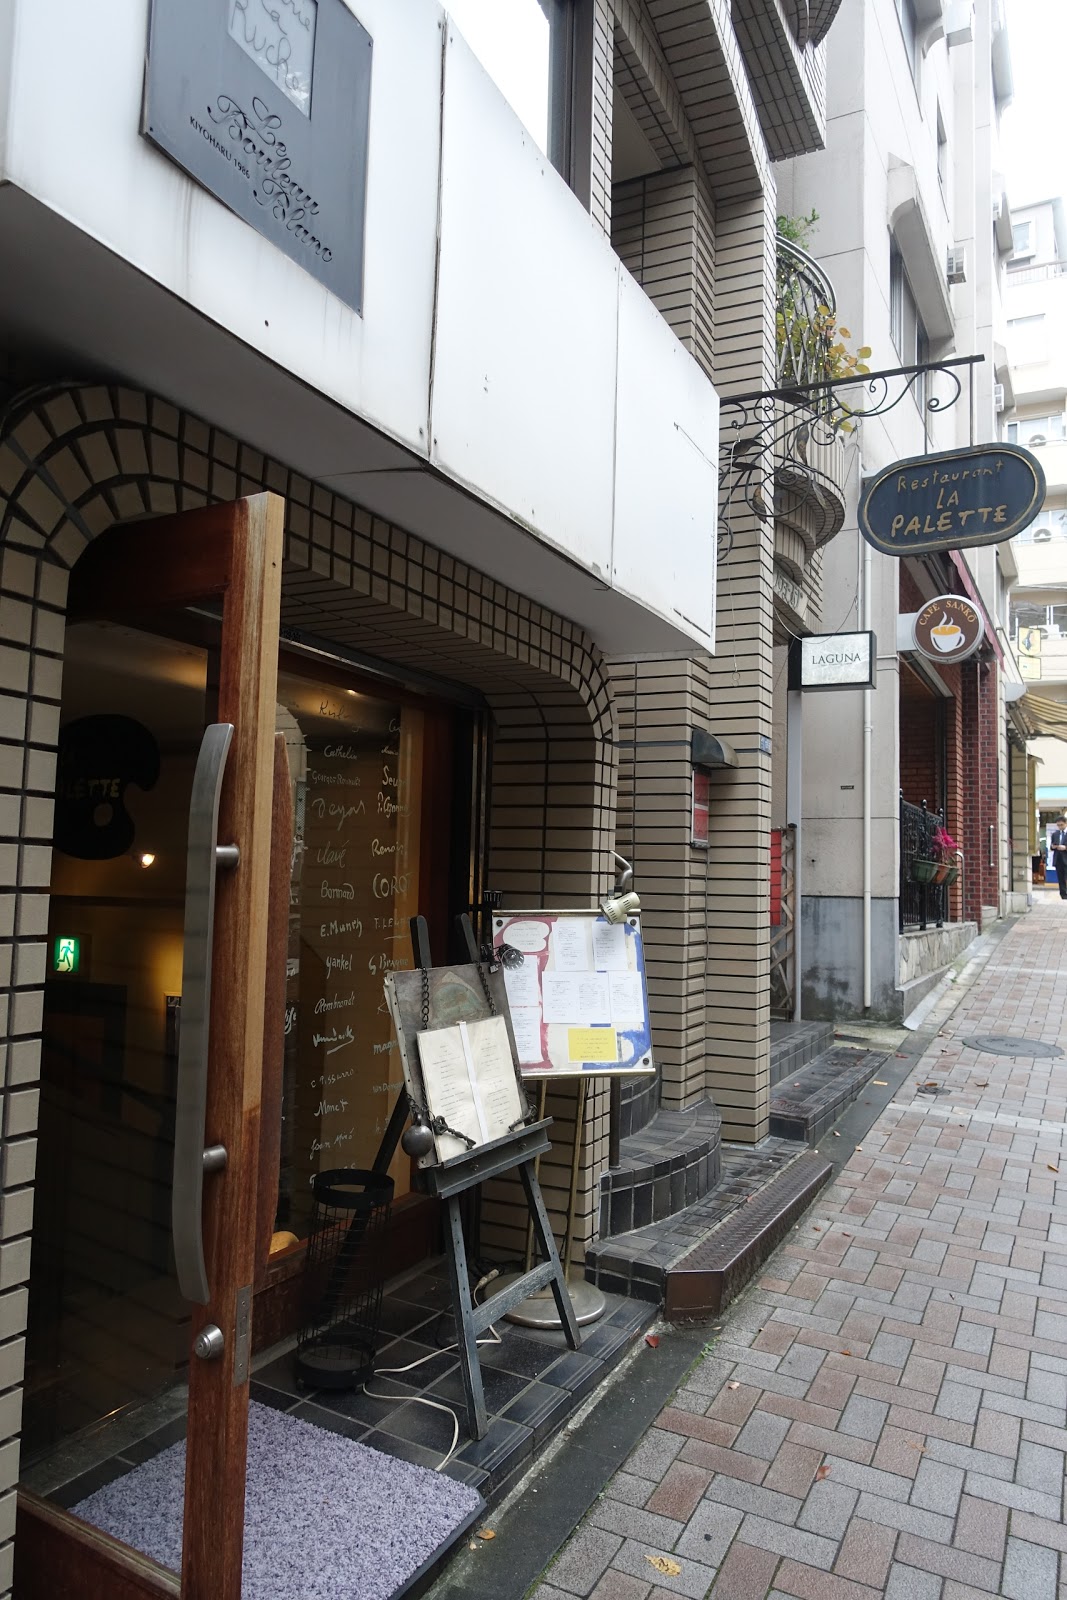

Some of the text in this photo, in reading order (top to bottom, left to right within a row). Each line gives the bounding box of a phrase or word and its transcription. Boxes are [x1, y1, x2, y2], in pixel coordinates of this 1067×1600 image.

[189, 115, 233, 161] KIYOHARU
[253, 178, 333, 262] Blanc
[897, 460, 1004, 493] Restaurant
[936, 487, 960, 510] LA
[891, 504, 1008, 538] PALETTE
[812, 652, 862, 665] LAGUNA
